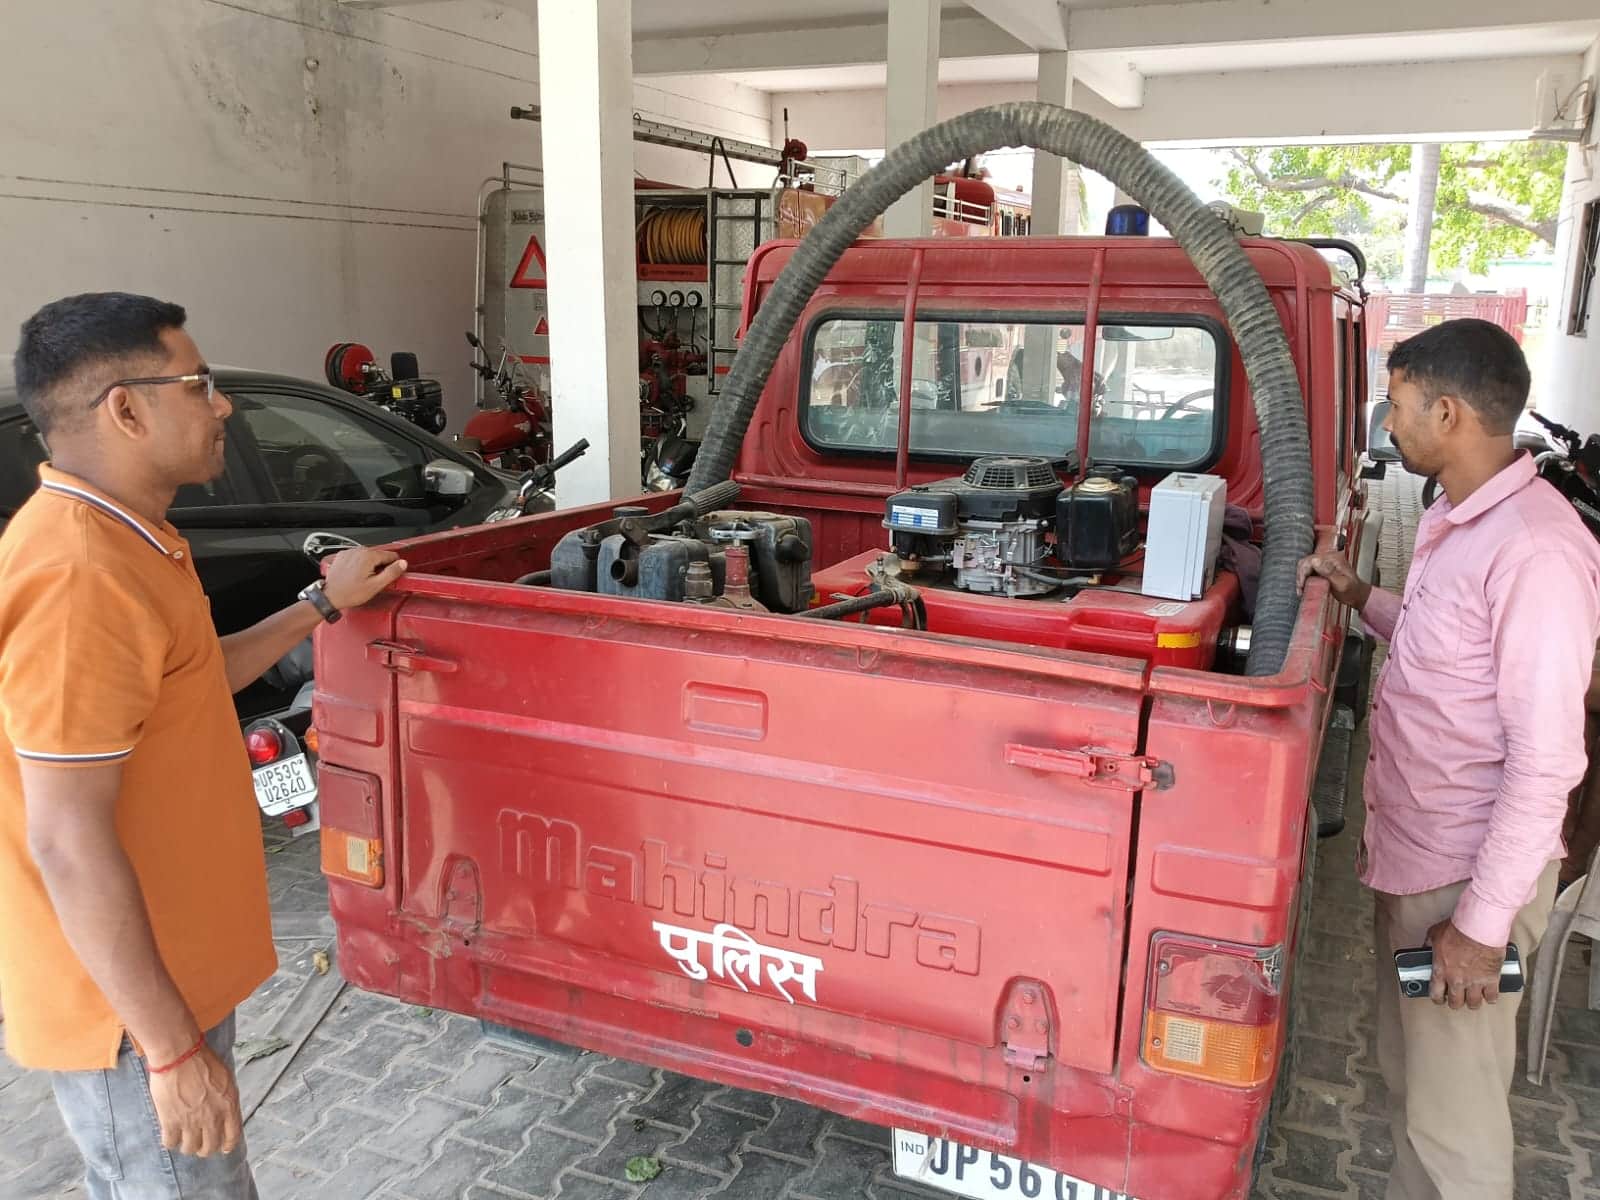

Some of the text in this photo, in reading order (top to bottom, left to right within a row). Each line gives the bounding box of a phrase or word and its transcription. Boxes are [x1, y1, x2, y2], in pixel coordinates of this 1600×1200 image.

[258, 761, 301, 788] UP53C
[264, 776, 306, 803] U2640
[652, 920, 825, 1004] पुलिस
[901, 1140, 924, 1155] IND
